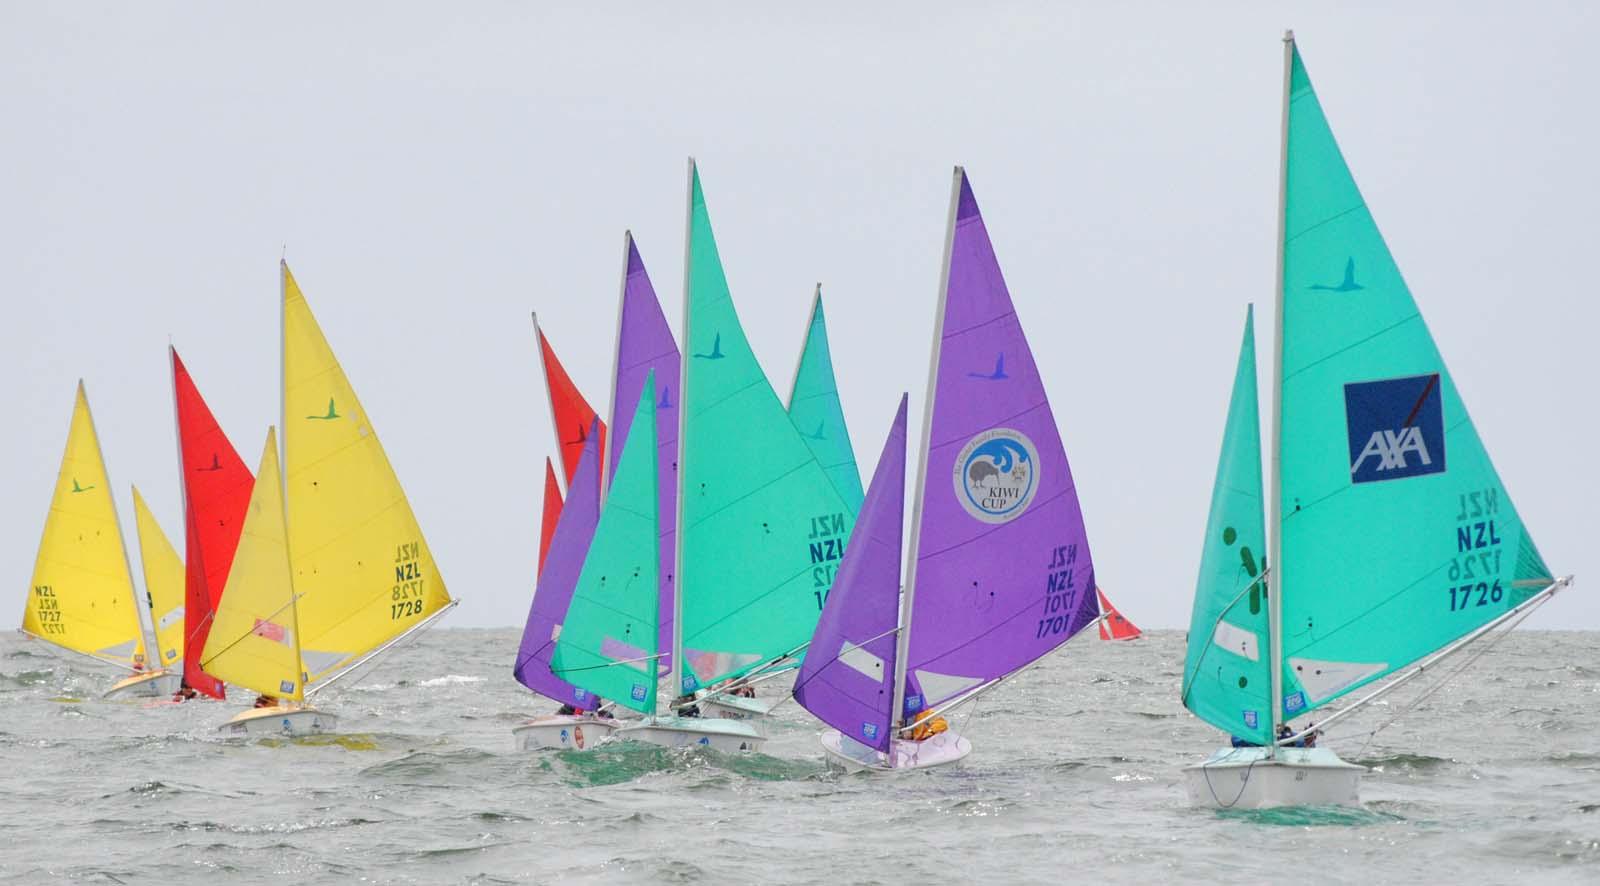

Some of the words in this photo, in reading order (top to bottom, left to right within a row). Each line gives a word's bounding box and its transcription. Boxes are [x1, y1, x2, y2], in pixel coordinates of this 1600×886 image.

[1350, 427, 1433, 474] AXA
[981, 498, 1008, 510] CUP
[988, 487, 1020, 499] KIWI
[1457, 519, 1502, 553] NZL
[395, 561, 421, 583] NZL
[1046, 569, 1074, 595] NZL
[35, 585, 56, 598] NZL
[1448, 578, 1504, 613] 1726
[38, 610, 61, 622] 1727
[391, 599, 423, 620] 1728
[1036, 613, 1071, 640] 1701
